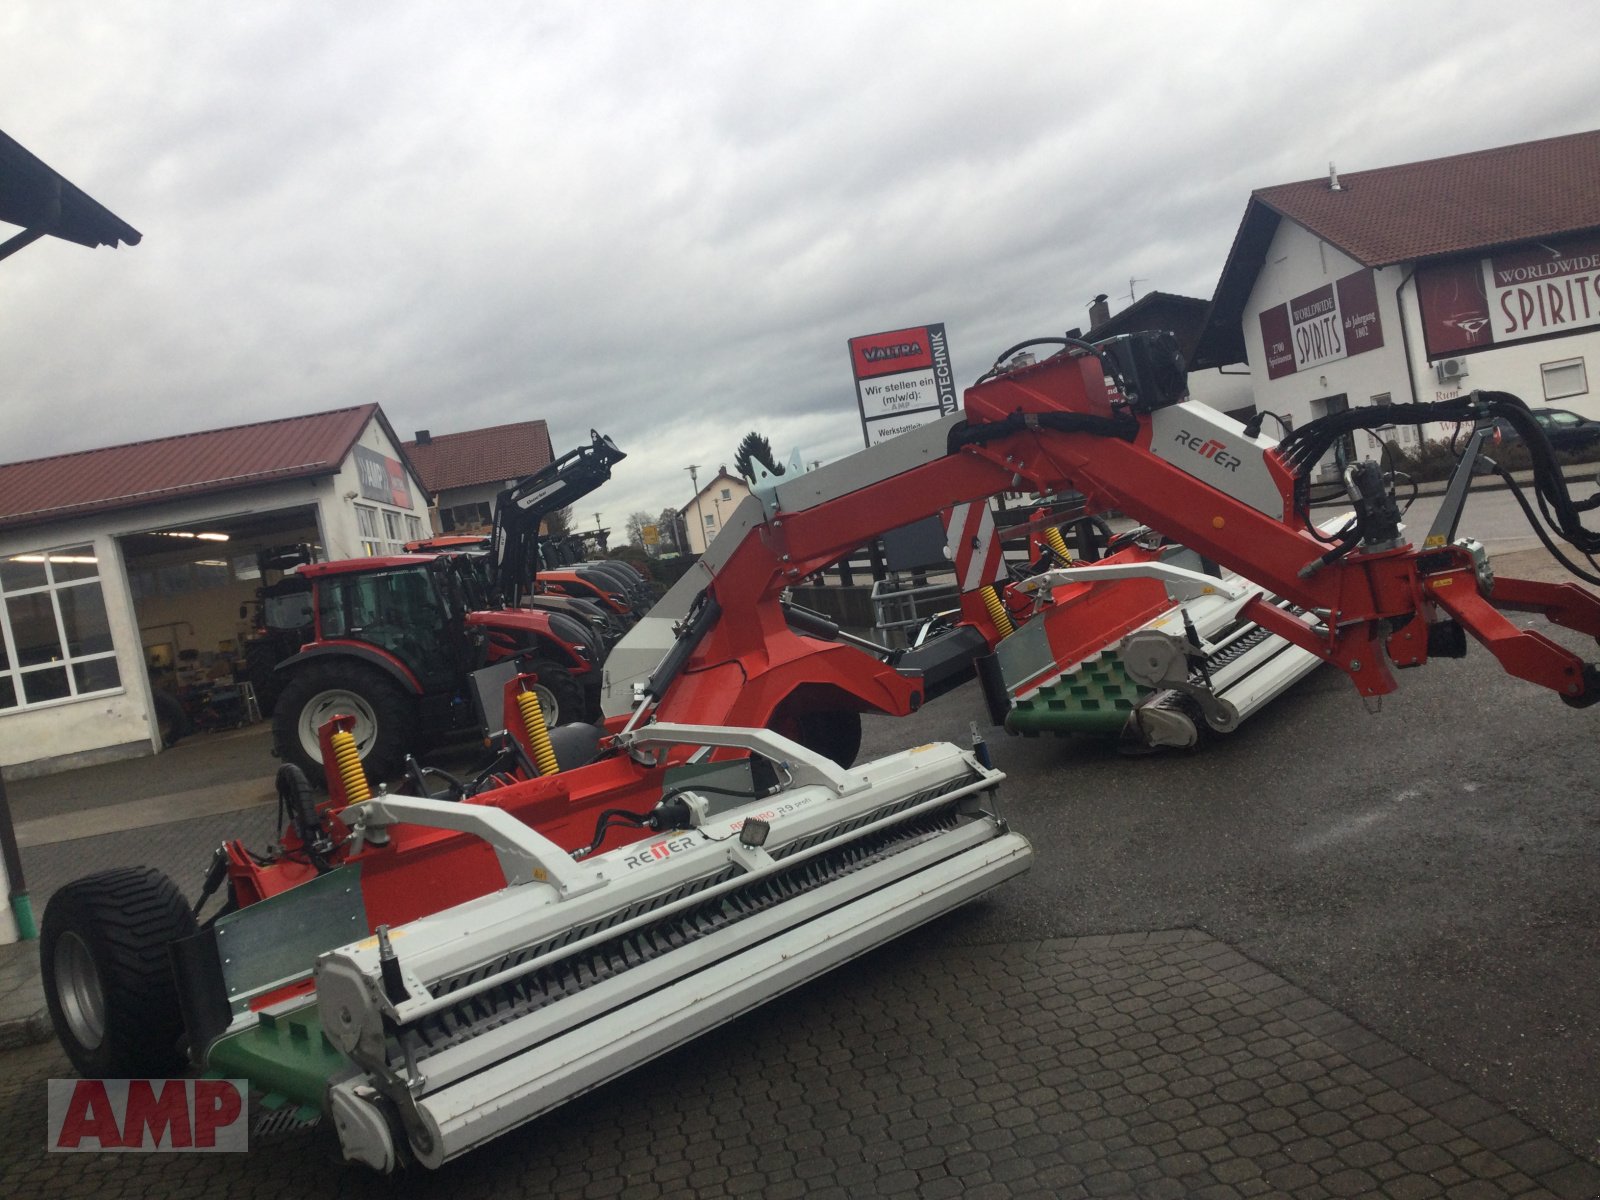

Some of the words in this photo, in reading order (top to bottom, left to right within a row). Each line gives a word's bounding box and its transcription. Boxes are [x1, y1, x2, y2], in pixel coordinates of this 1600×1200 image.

[1499, 255, 1600, 283] WORLDWIDE
[1296, 314, 1341, 364] SPIRITS
[862, 342, 922, 362] VALTRA
[865, 386, 882, 396] Wir
[885, 381, 917, 393] stellen
[919, 378, 934, 387] ein
[1435, 391, 1459, 401] Rum
[1175, 429, 1242, 472] REITER
[730, 810, 775, 831] REIRO
[624, 836, 696, 870] REITER
